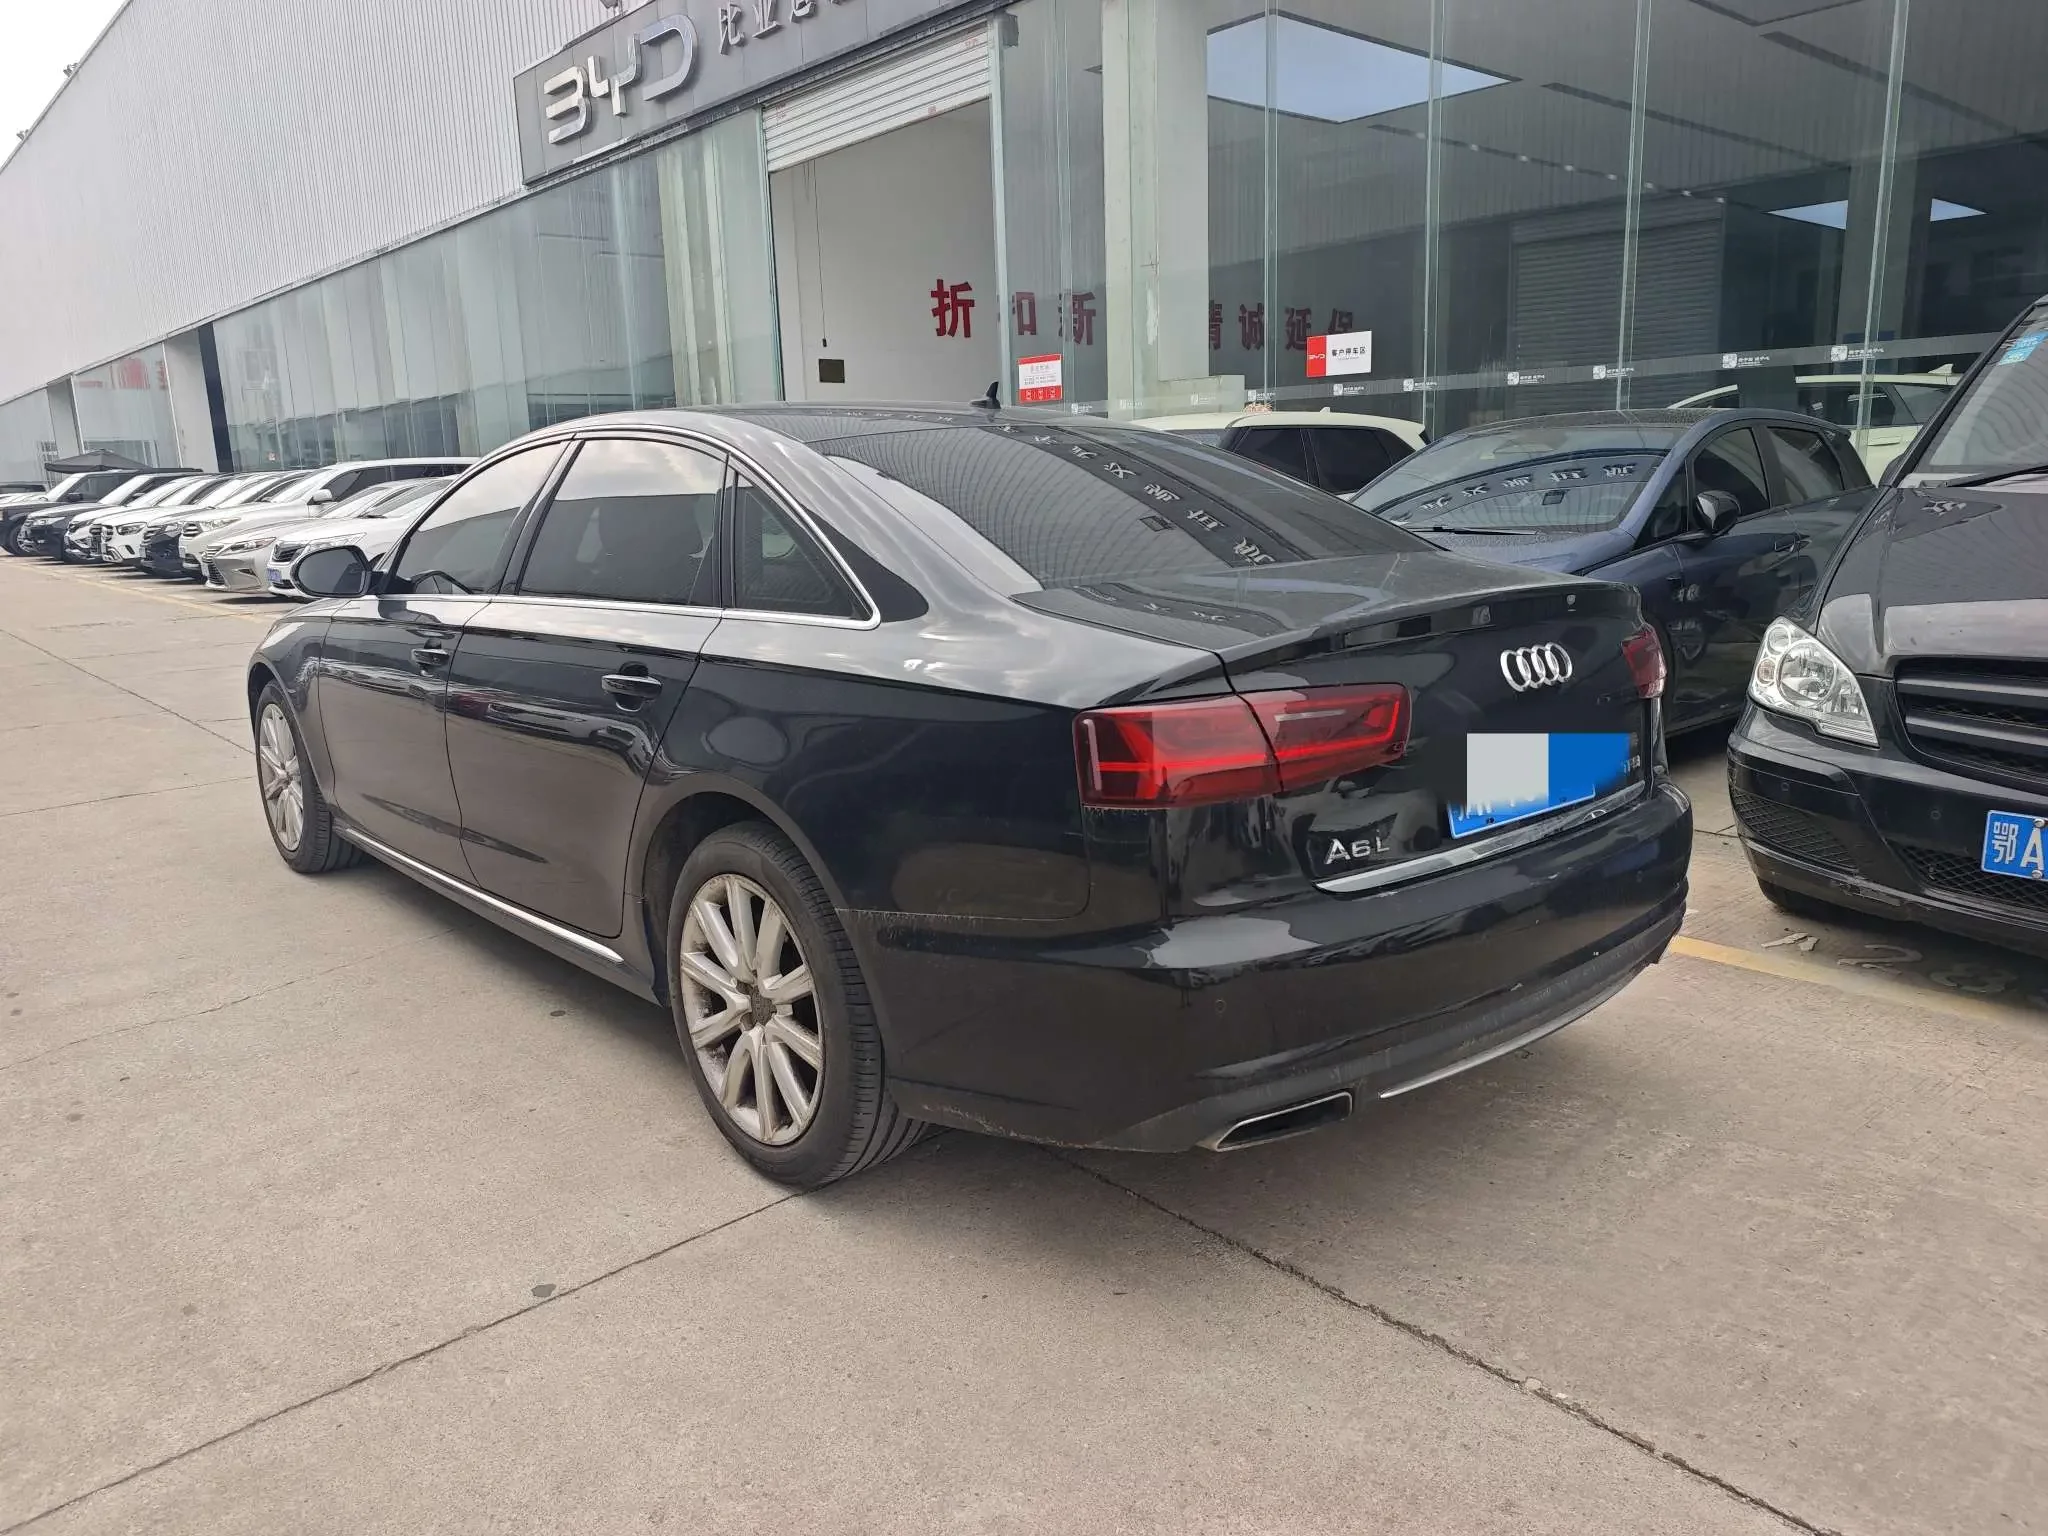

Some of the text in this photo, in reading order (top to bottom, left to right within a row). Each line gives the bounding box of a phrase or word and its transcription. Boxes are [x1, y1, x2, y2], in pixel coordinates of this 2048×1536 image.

[543, 15, 696, 144] BYD
[1324, 836, 1390, 865] A6L
[1991, 821, 2045, 872] 鄂A
